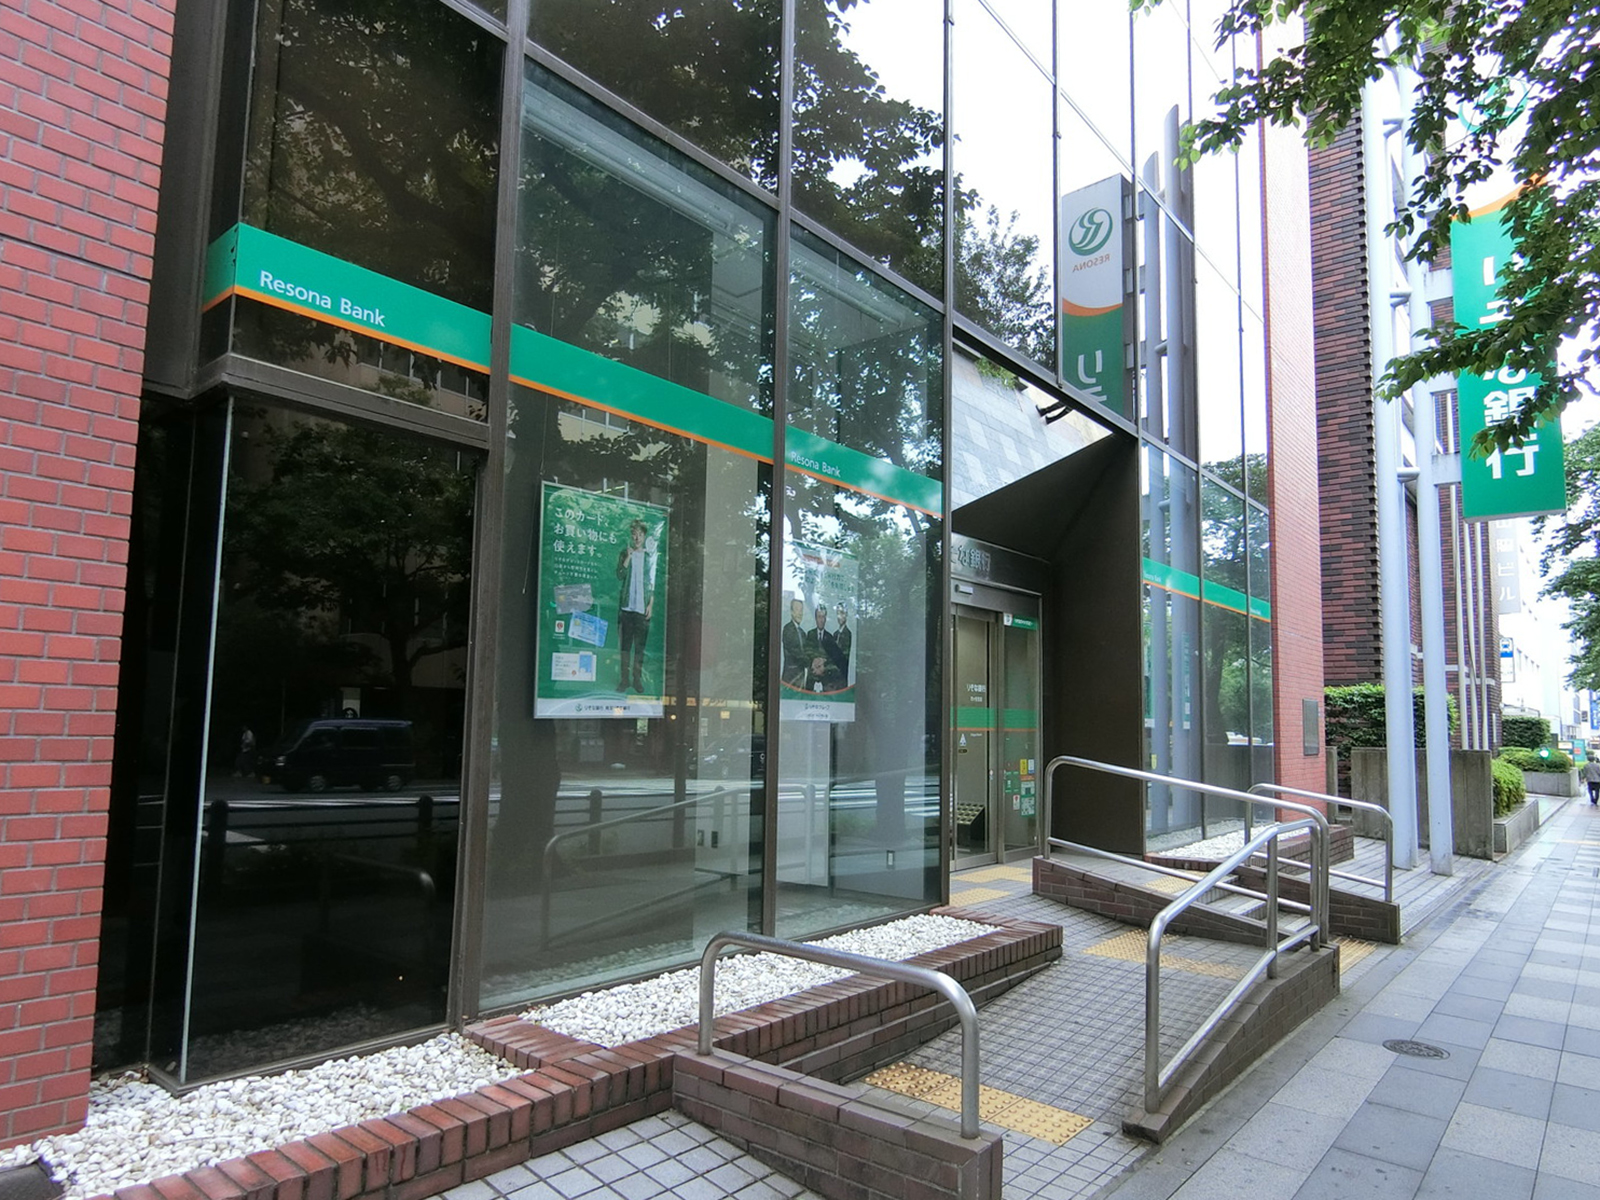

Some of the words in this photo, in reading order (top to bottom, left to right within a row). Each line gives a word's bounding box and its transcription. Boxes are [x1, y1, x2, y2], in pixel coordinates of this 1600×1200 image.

[260, 270, 332, 309] Resona
[340, 297, 386, 328] Bank
[791, 451, 820, 470] Resona
[822, 461, 841, 478] Bank
[554, 507, 609, 527] このカード、
[553, 522, 618, 545] お買い物にも
[553, 539, 603, 558] 使えます。
